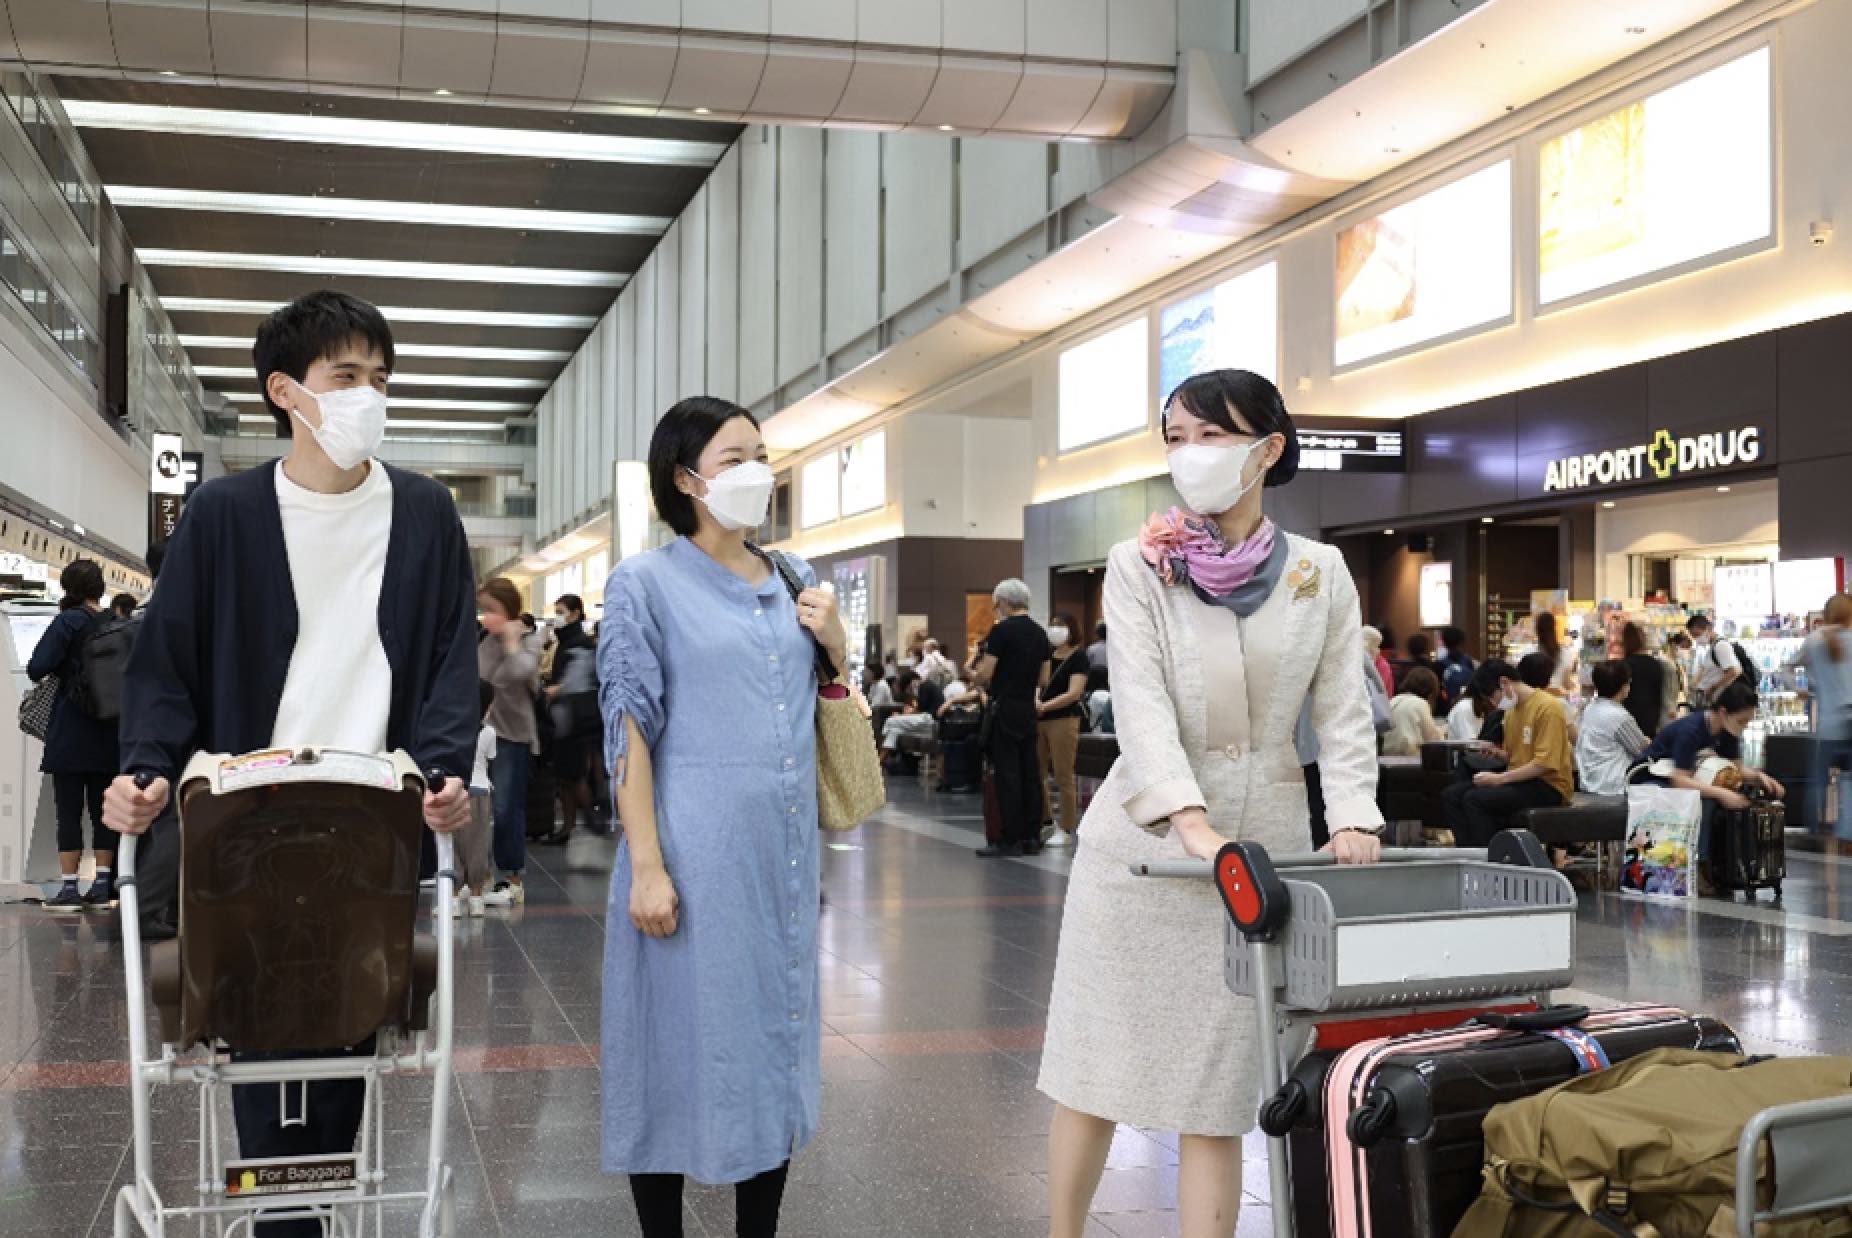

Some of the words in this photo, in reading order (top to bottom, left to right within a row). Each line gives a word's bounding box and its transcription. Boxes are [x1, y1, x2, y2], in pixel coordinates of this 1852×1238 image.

[1543, 444, 1647, 492] AIRPORT
[1677, 426, 1759, 473] DRUG
[259, 1168, 283, 1182] For
[287, 1165, 351, 1183] Baggage
